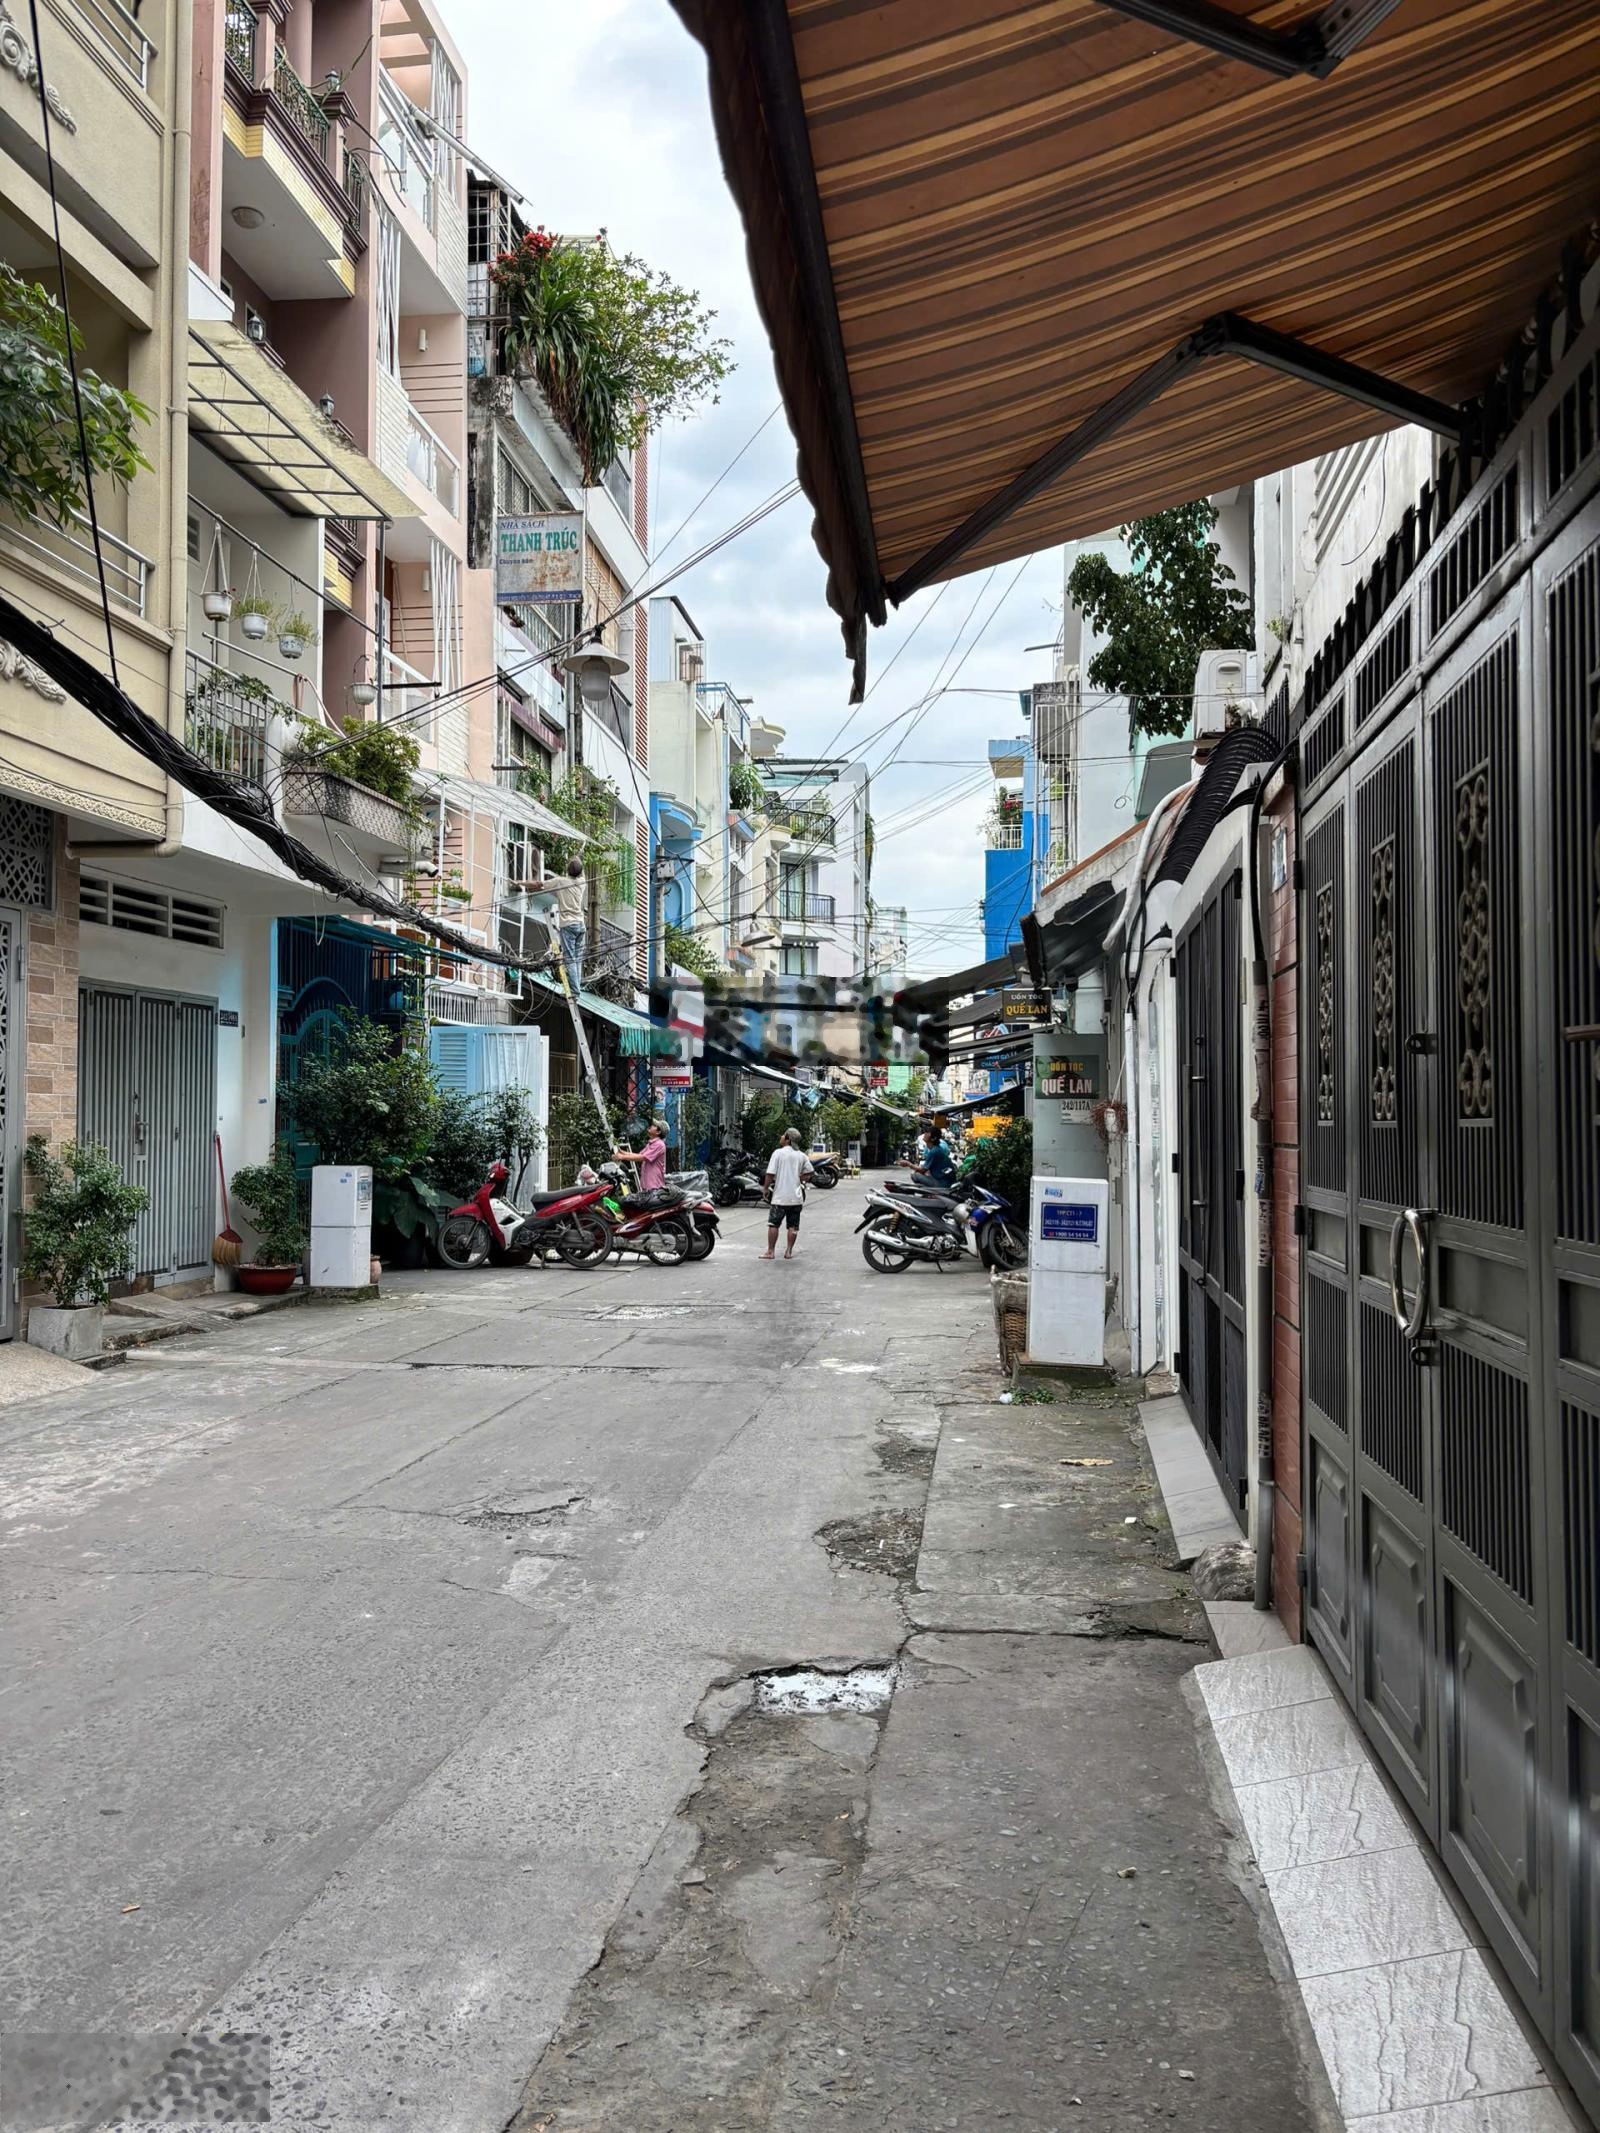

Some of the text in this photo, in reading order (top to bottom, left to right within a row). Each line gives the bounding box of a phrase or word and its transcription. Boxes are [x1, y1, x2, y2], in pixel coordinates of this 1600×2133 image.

[500, 526, 577, 552] THANH TRÚC
[1006, 1001, 1048, 1016] QUẾ LAN
[1041, 1075, 1093, 1096] QUẾ LAN
